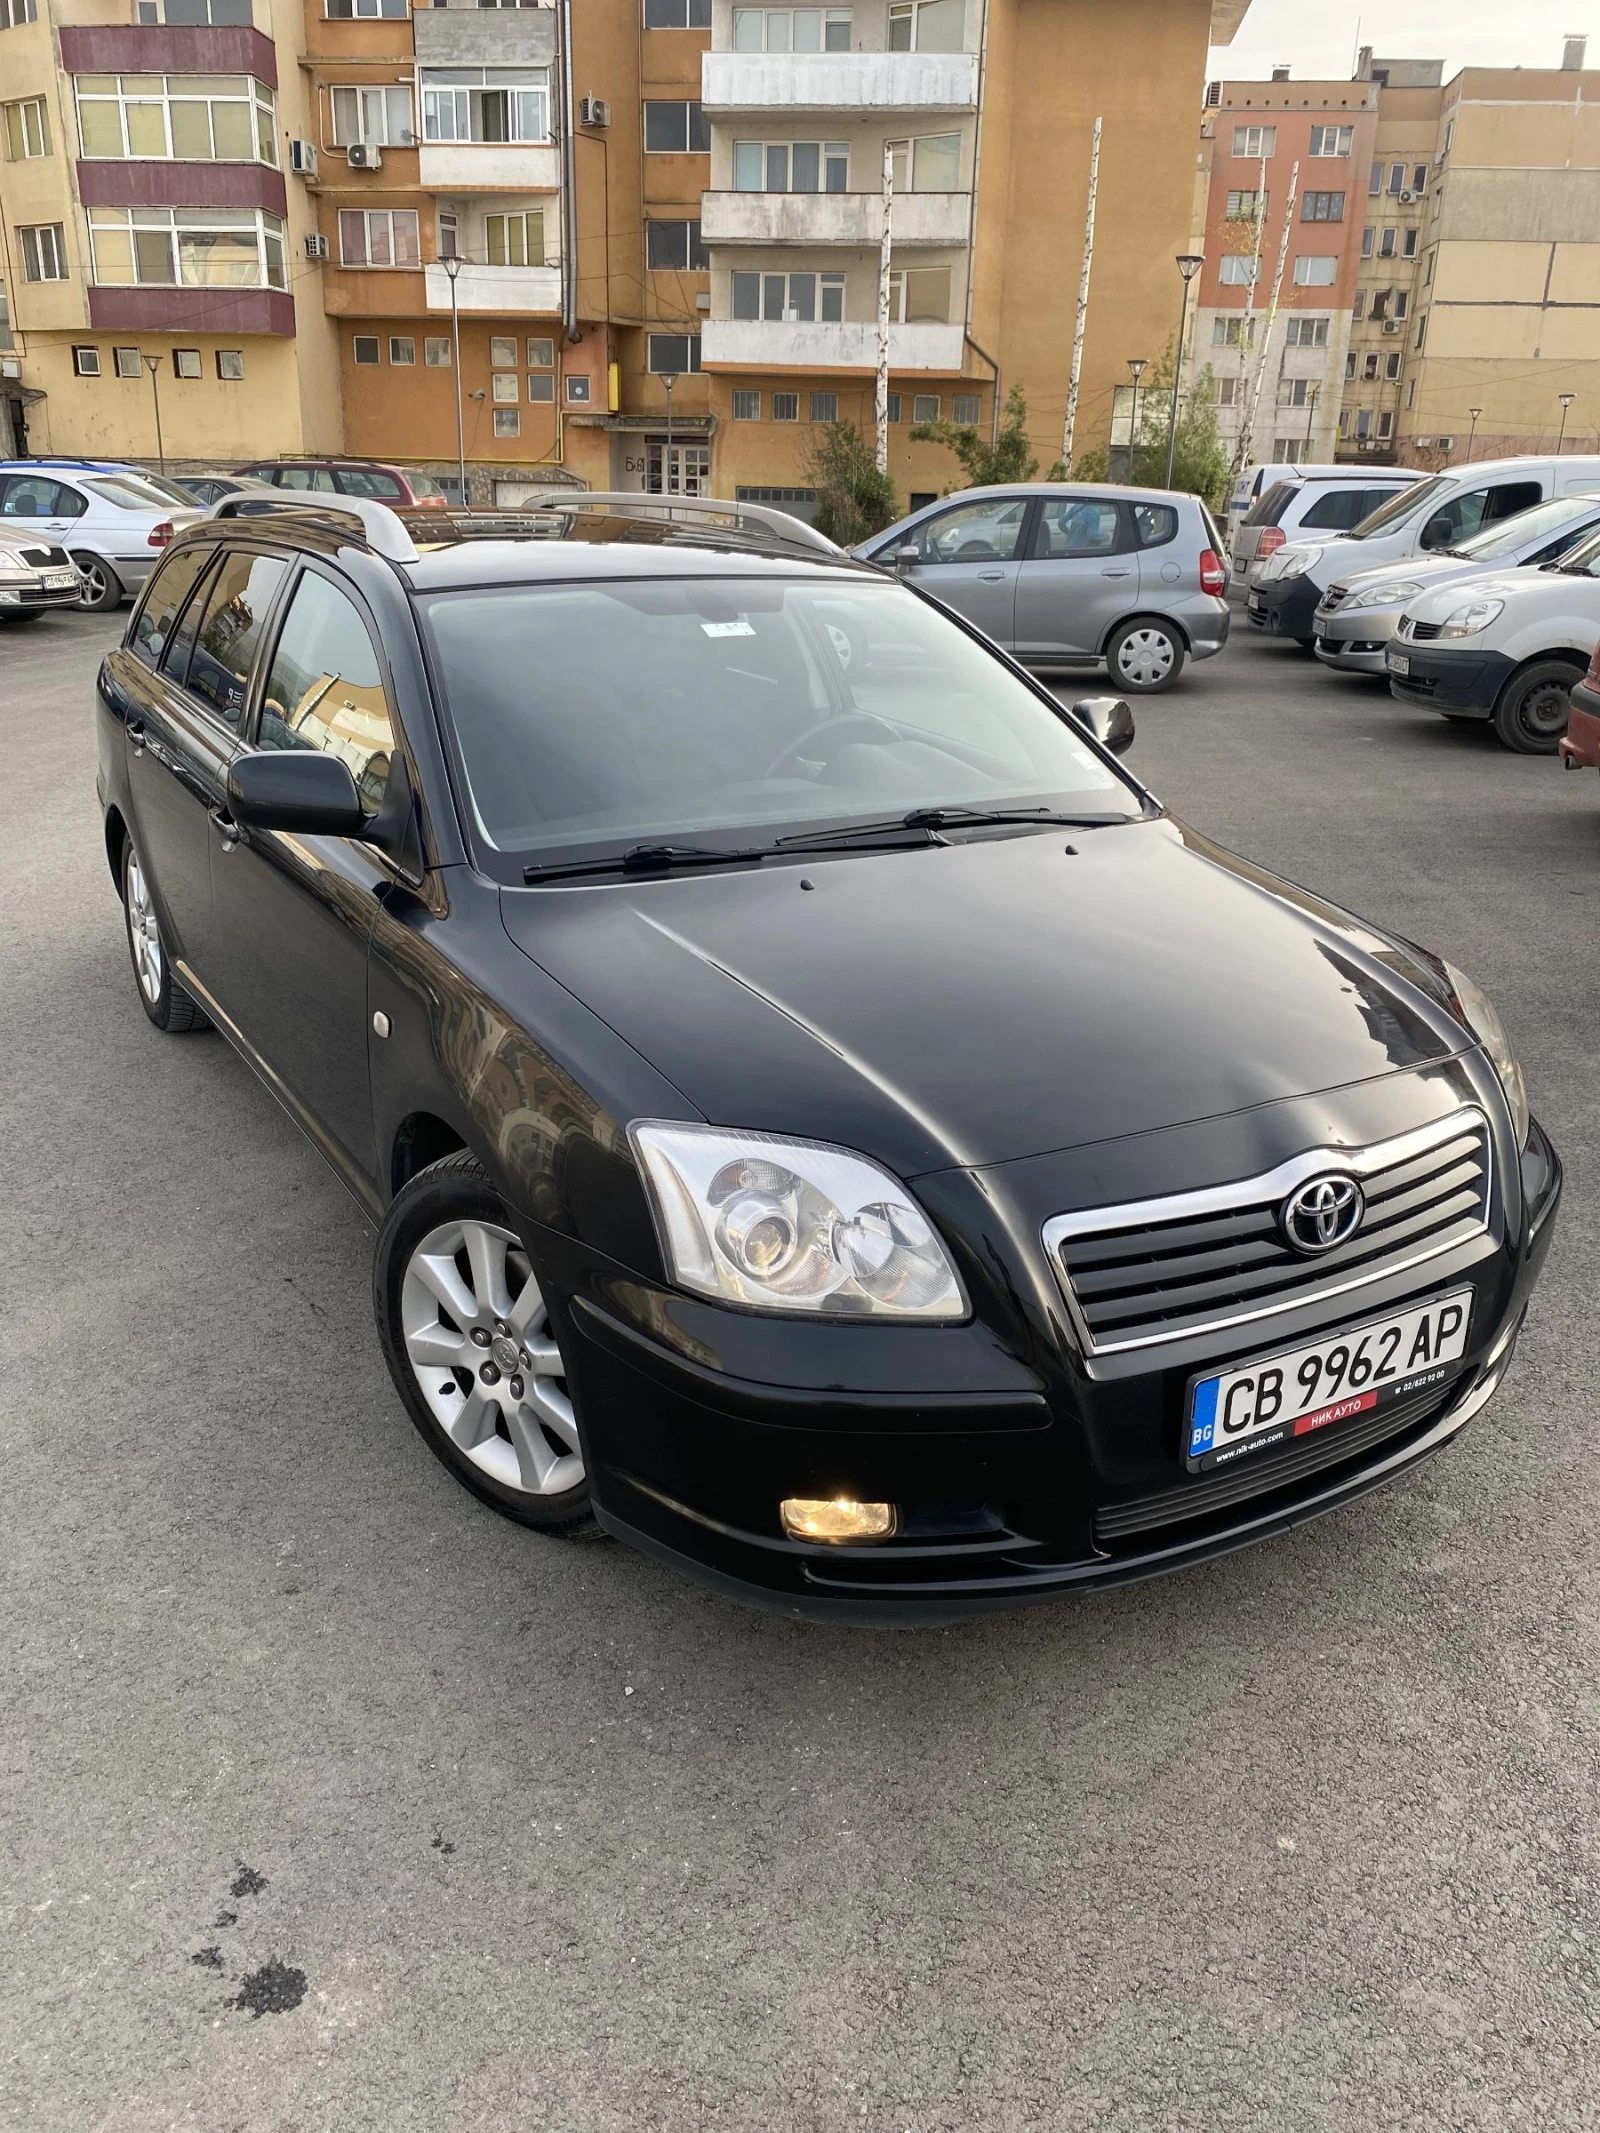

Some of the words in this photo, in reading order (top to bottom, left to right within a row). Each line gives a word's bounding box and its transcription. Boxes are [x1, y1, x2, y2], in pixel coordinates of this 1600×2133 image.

[1222, 1367, 1284, 1434] CB
[1297, 1326, 1402, 1409] 9962
[1406, 1304, 1463, 1369] AP
[1436, 1370, 1445, 1380] 00
[1311, 1410, 1333, 1427] НИК
[1334, 1400, 1362, 1418] АУТО
[1193, 1423, 1212, 1447] BG
[1215, 1431, 1284, 1463] www.nik-auto.com
